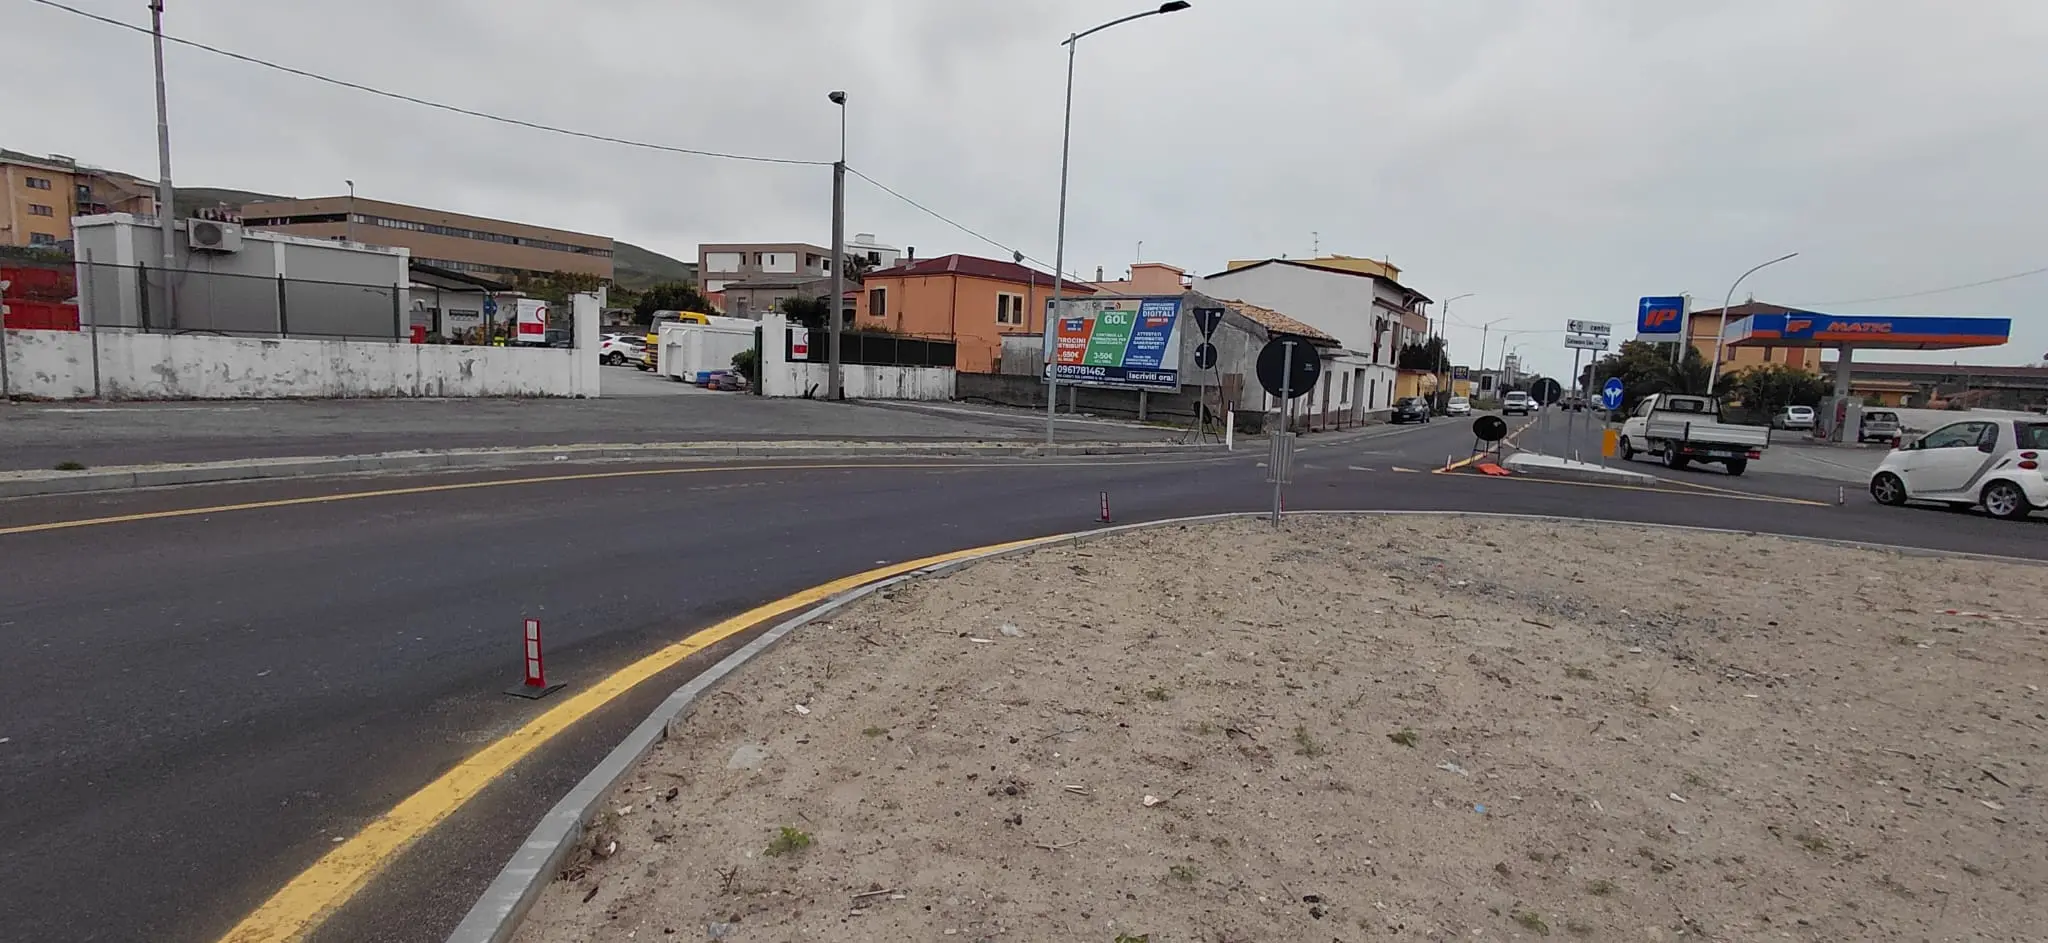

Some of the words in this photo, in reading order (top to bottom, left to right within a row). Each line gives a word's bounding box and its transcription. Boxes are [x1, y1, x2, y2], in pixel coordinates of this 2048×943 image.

[1104, 314, 1128, 324] GOL
[1644, 309, 1678, 327] IP
[1590, 324, 1610, 332] centro
[1826, 321, 1892, 333] MATIC
[1057, 365, 1106, 376] 0961781462
[1129, 372, 1157, 381] Iscriviti
